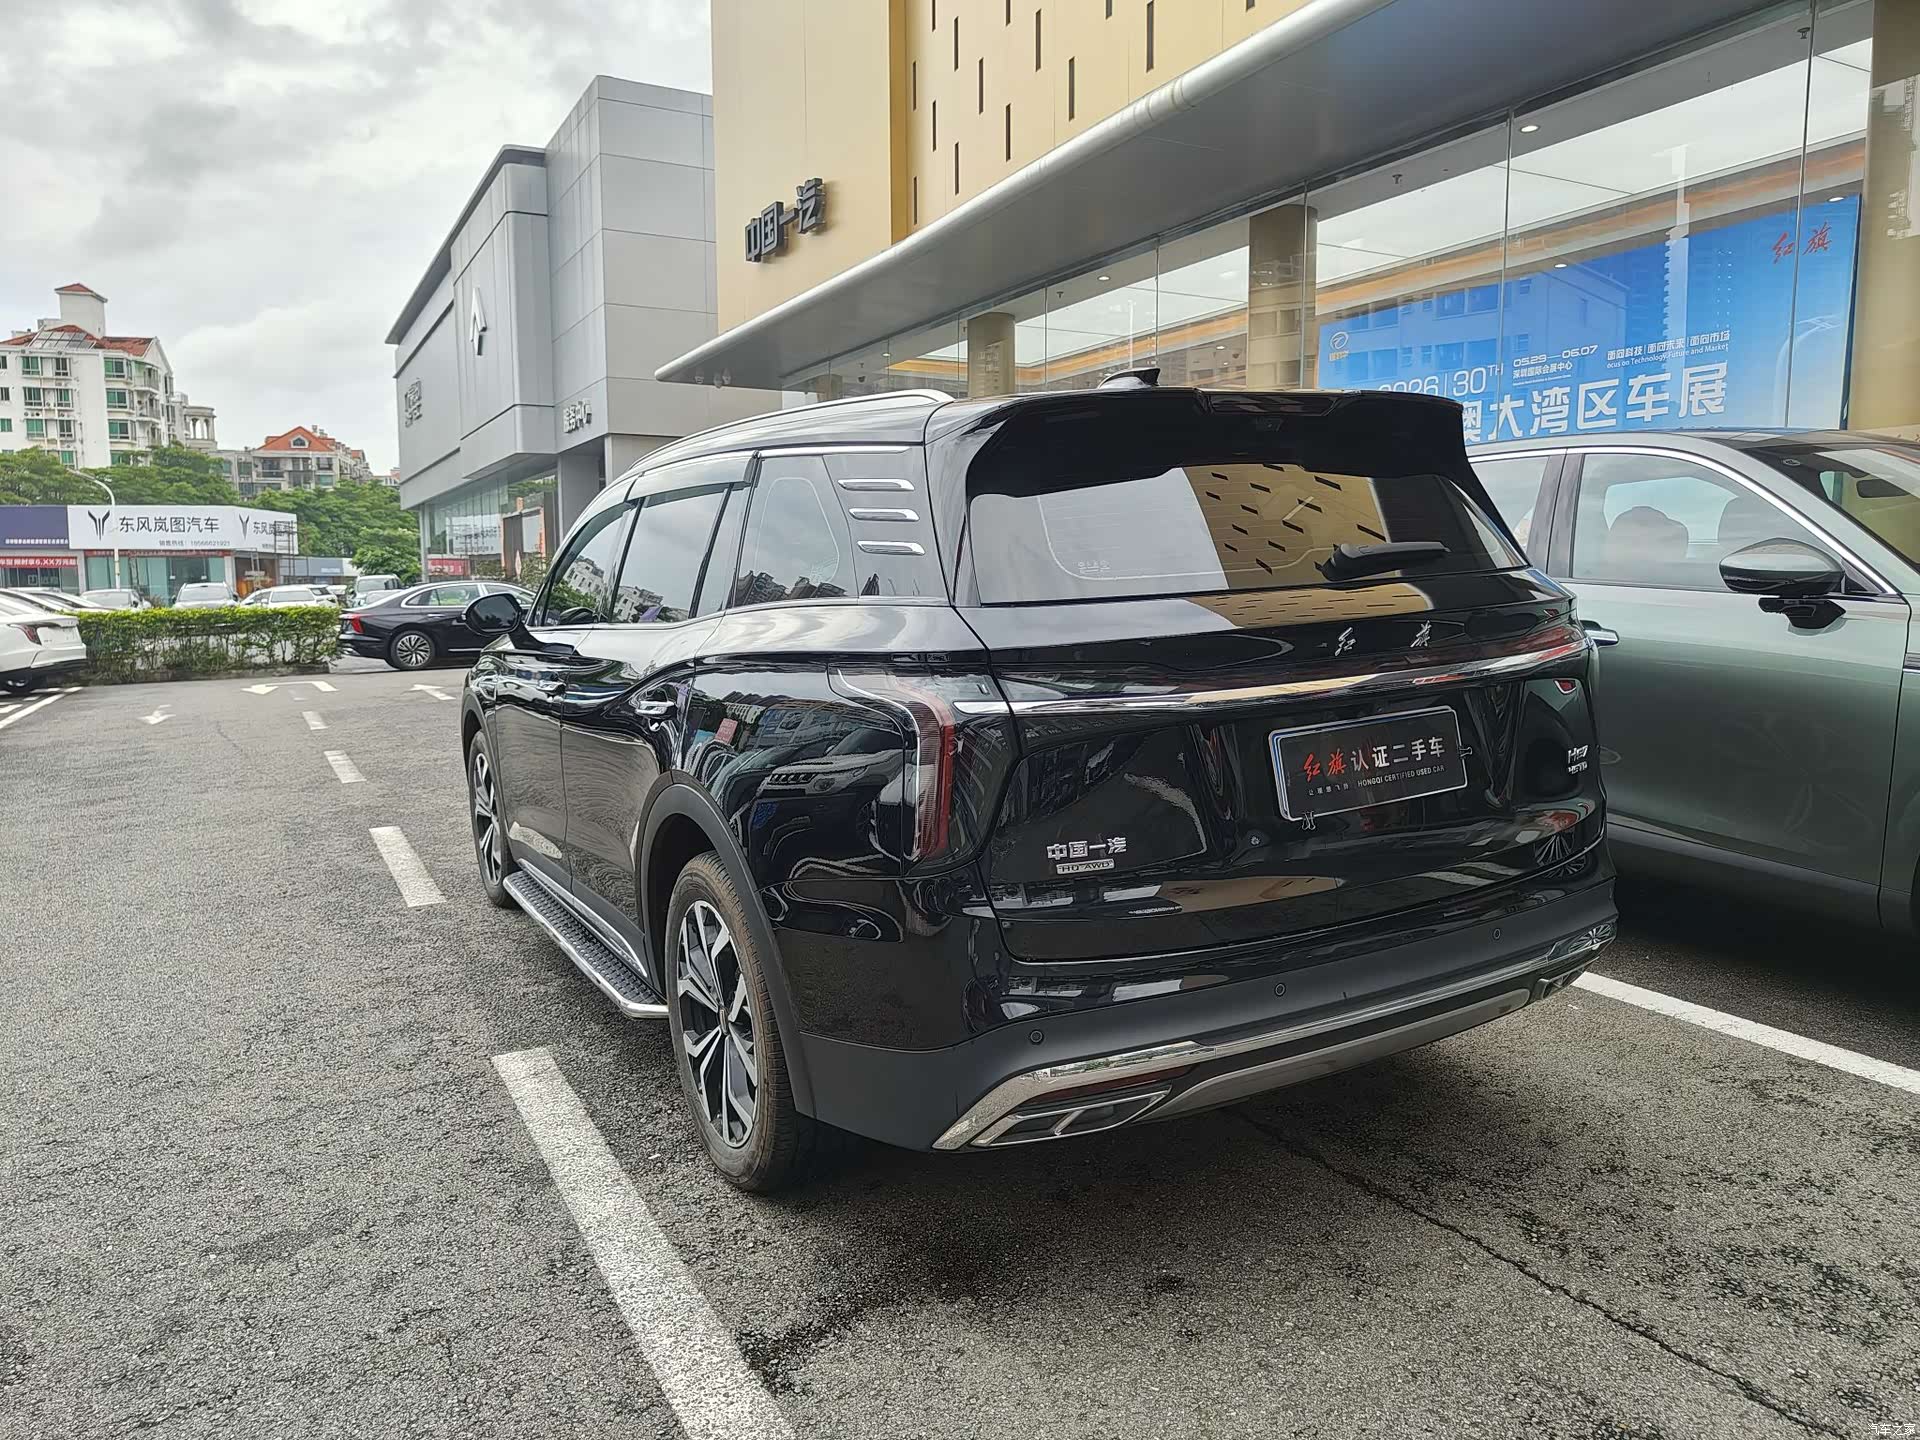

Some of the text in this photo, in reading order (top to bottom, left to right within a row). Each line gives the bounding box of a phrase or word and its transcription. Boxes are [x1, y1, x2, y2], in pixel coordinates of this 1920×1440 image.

[744, 177, 823, 263] 中国一汽
[1772, 221, 1832, 265] 红旗
[118, 516, 220, 533] 东风岚图汽车
[1334, 620, 1432, 657] 红旗
[1303, 736, 1446, 782] 红旗认证二手车
[1357, 764, 1445, 788] HONGQI CERTIFIED USED CAR
[1046, 836, 1127, 860] 中国一汽
